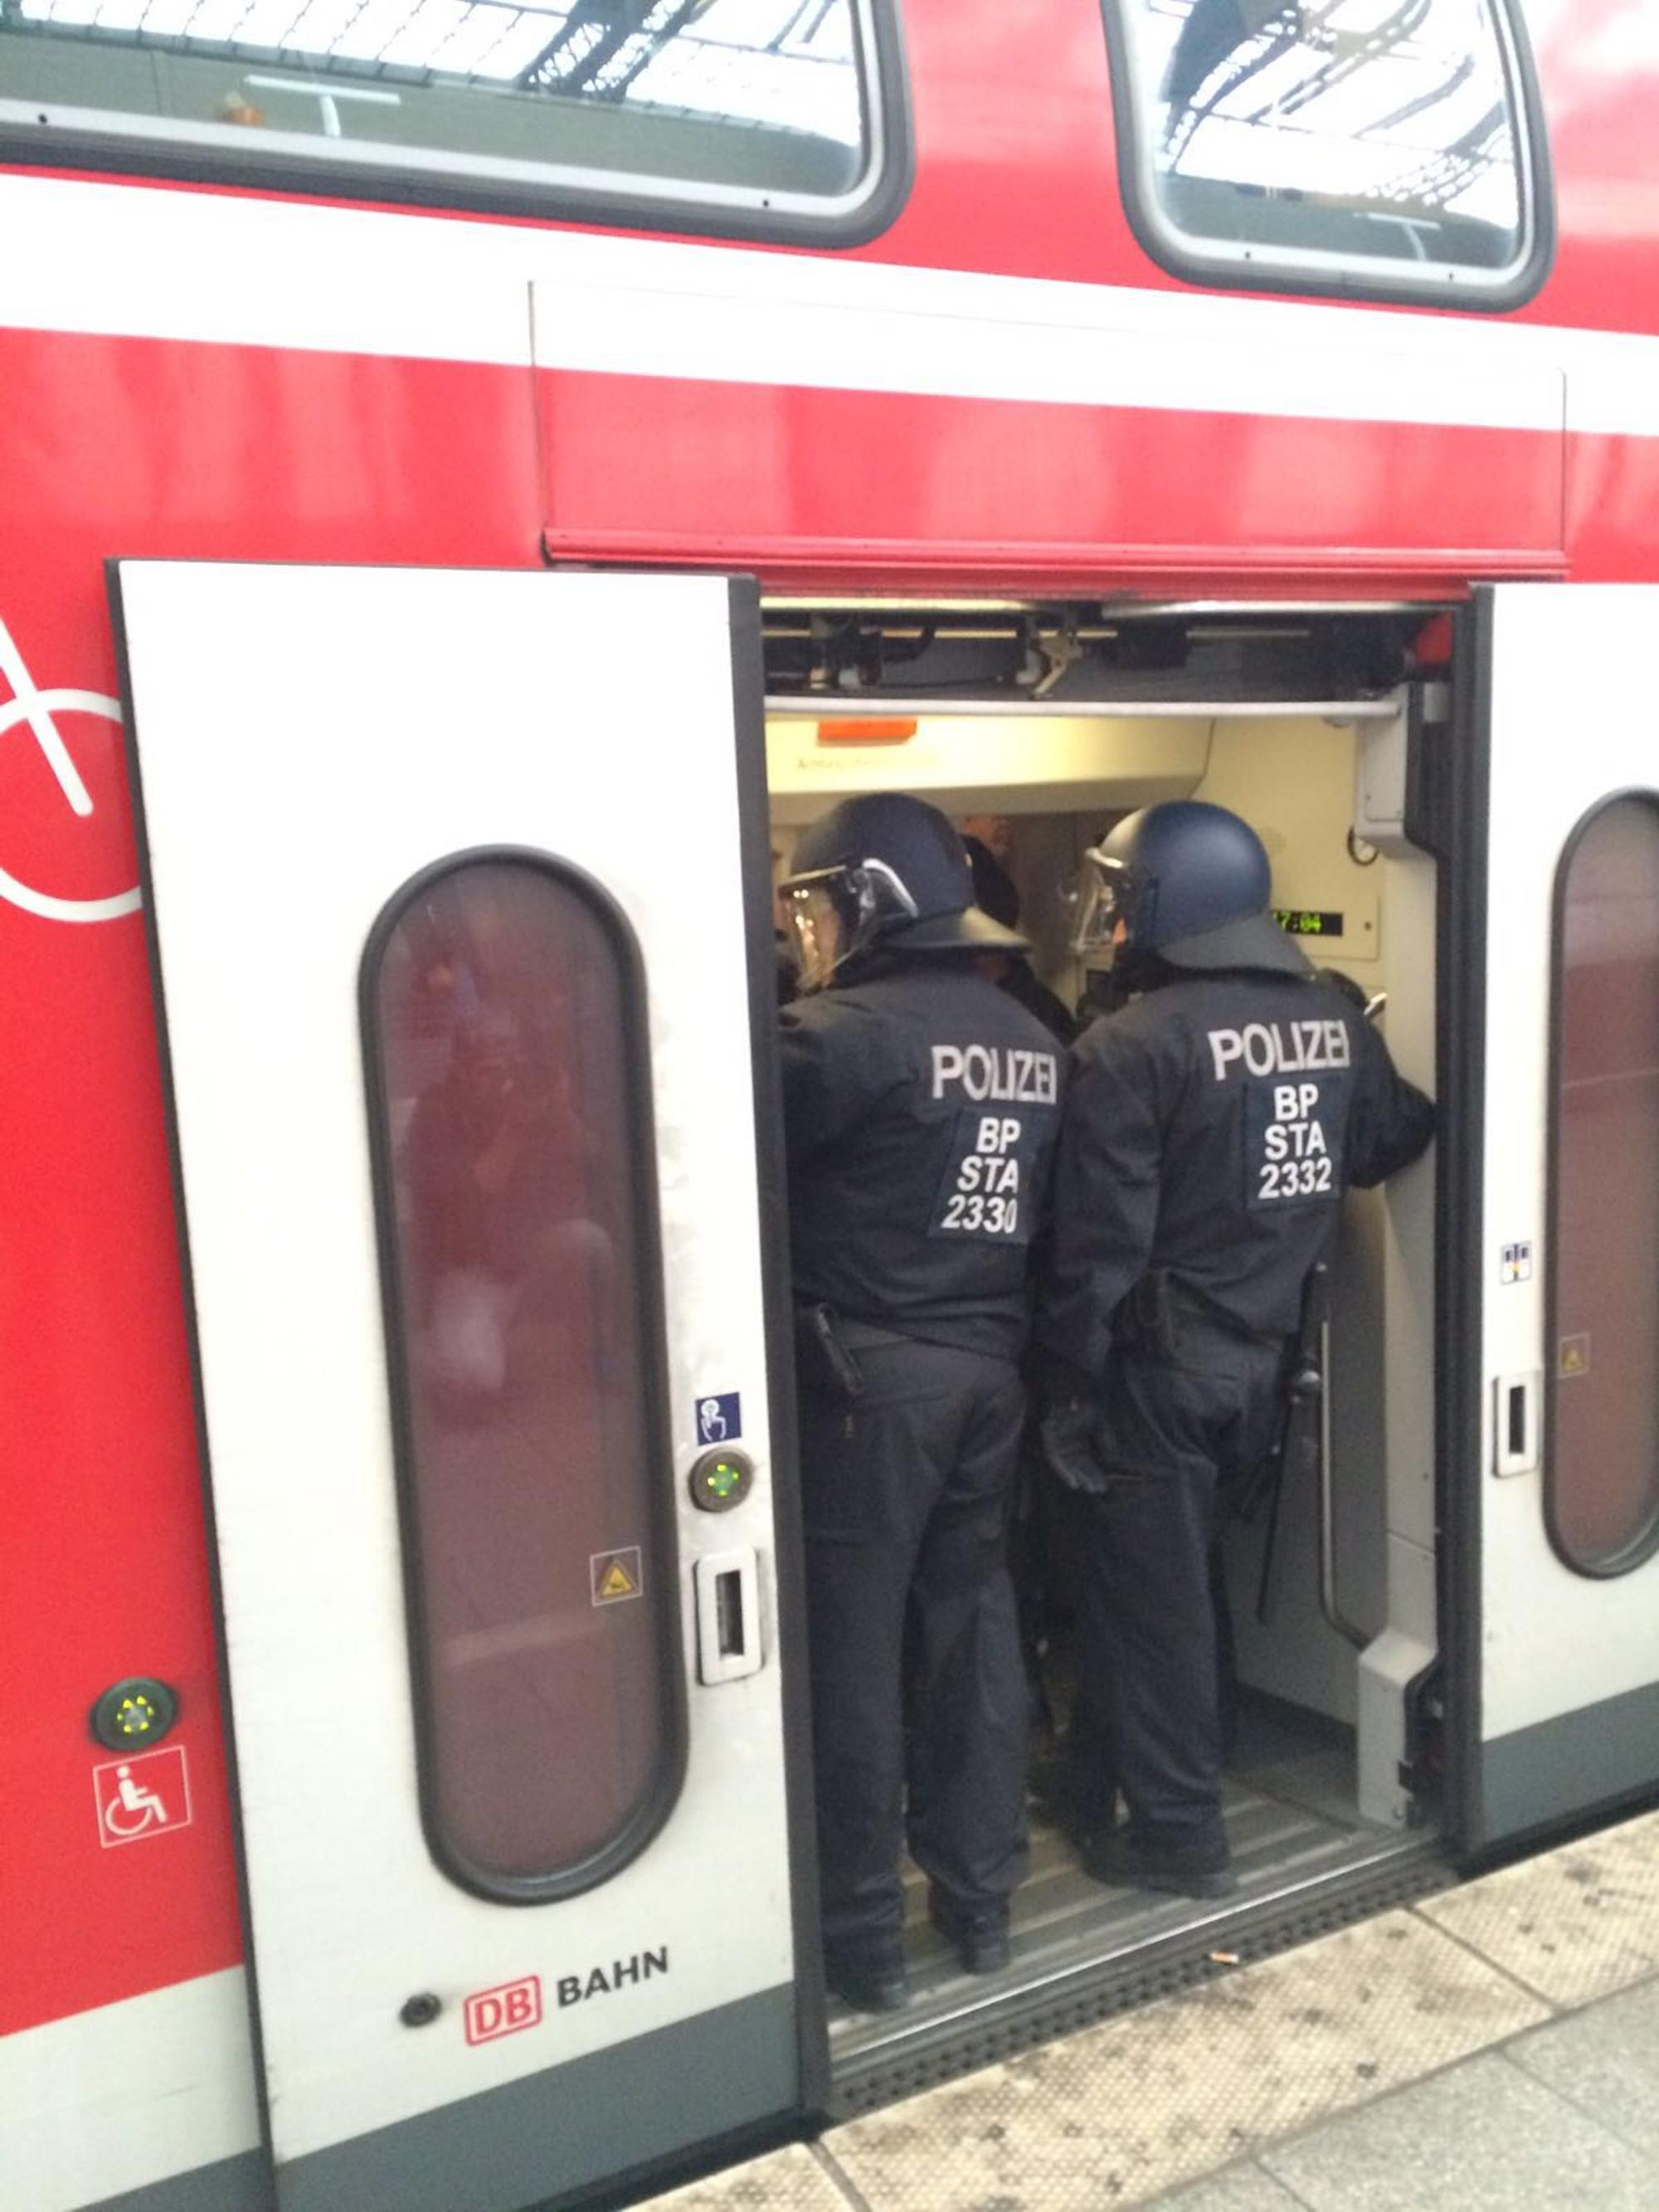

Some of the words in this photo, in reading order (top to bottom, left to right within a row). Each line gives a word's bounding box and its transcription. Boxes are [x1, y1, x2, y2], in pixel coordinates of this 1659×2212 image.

[1207, 1020, 1351, 1081] POLIZEI
[931, 1045, 1058, 1105] POLIZEI
[1273, 1084, 1320, 1122] BP
[975, 1117, 1021, 1154] BP
[1264, 1123, 1327, 1161] STA
[956, 1156, 1019, 1195] STA
[1258, 1157, 1333, 1200] 2332
[941, 1195, 1018, 1235] 2330
[473, 1986, 533, 2037] DB
[556, 1946, 669, 2009] BAHN
